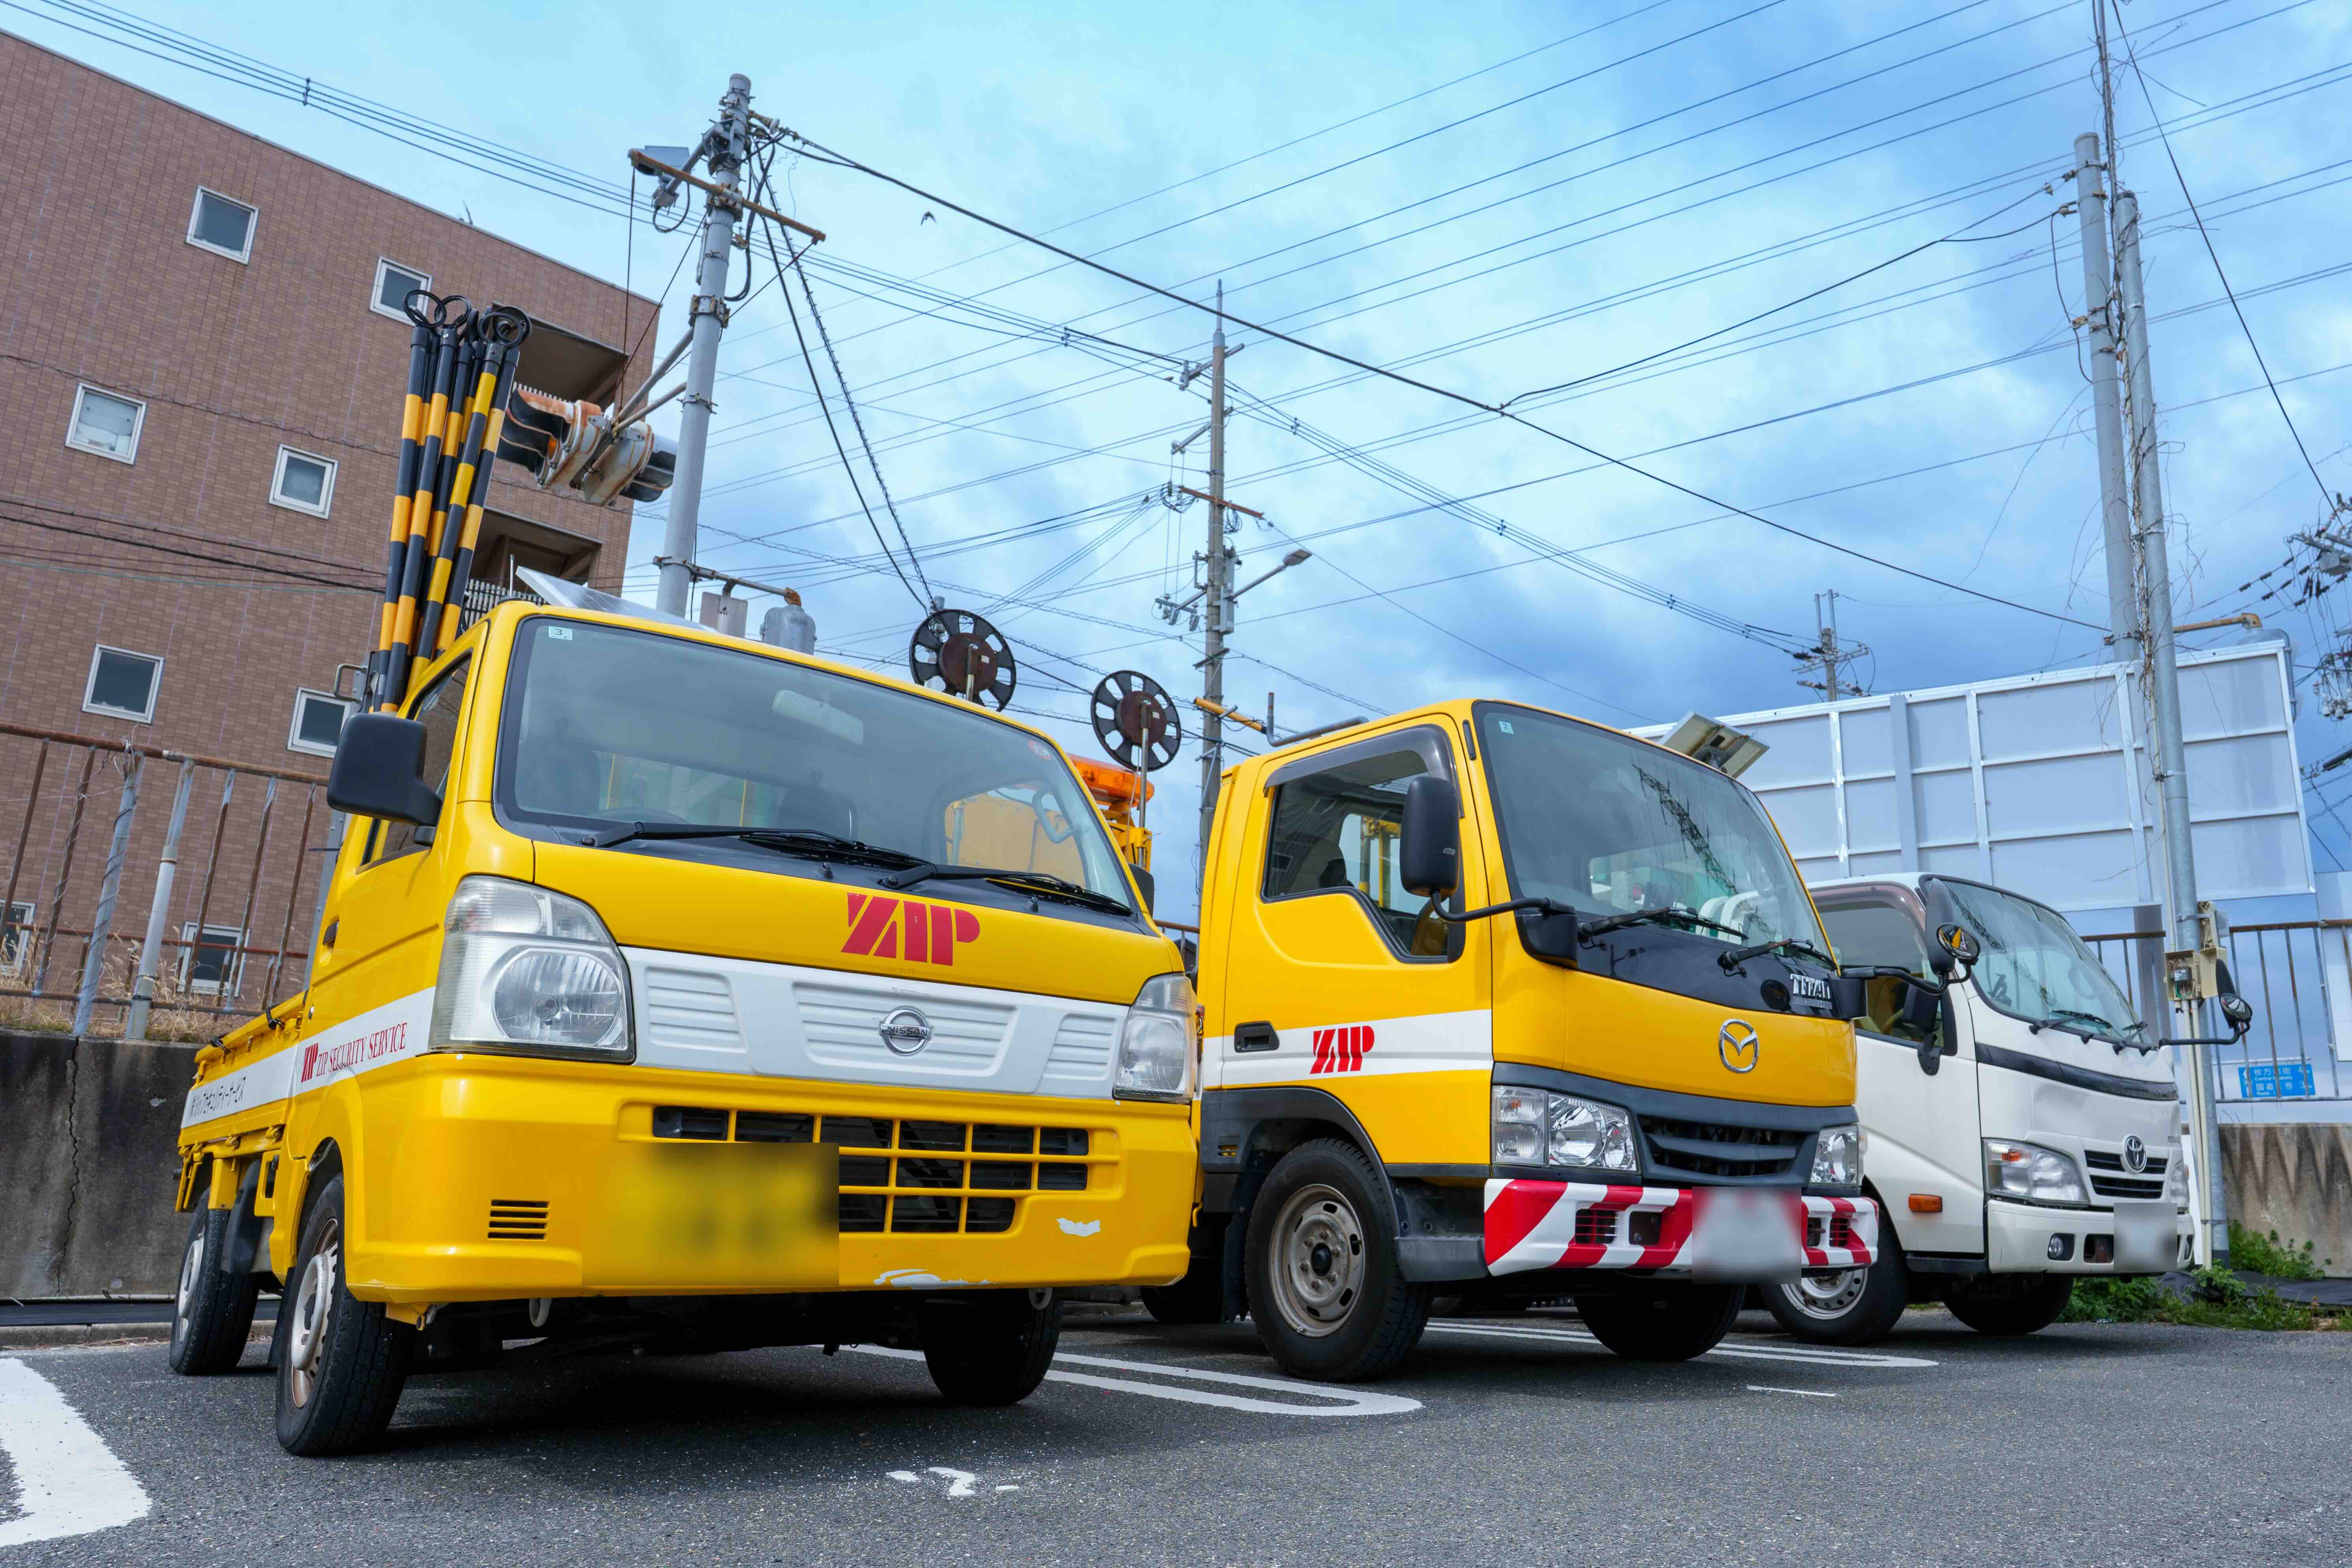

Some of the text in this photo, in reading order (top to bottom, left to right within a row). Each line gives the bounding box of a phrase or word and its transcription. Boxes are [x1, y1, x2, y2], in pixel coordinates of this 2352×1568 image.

[888, 1026, 928, 1037] NISSAN
[317, 1022, 407, 1077] ZIP SECURITY SERVICE
